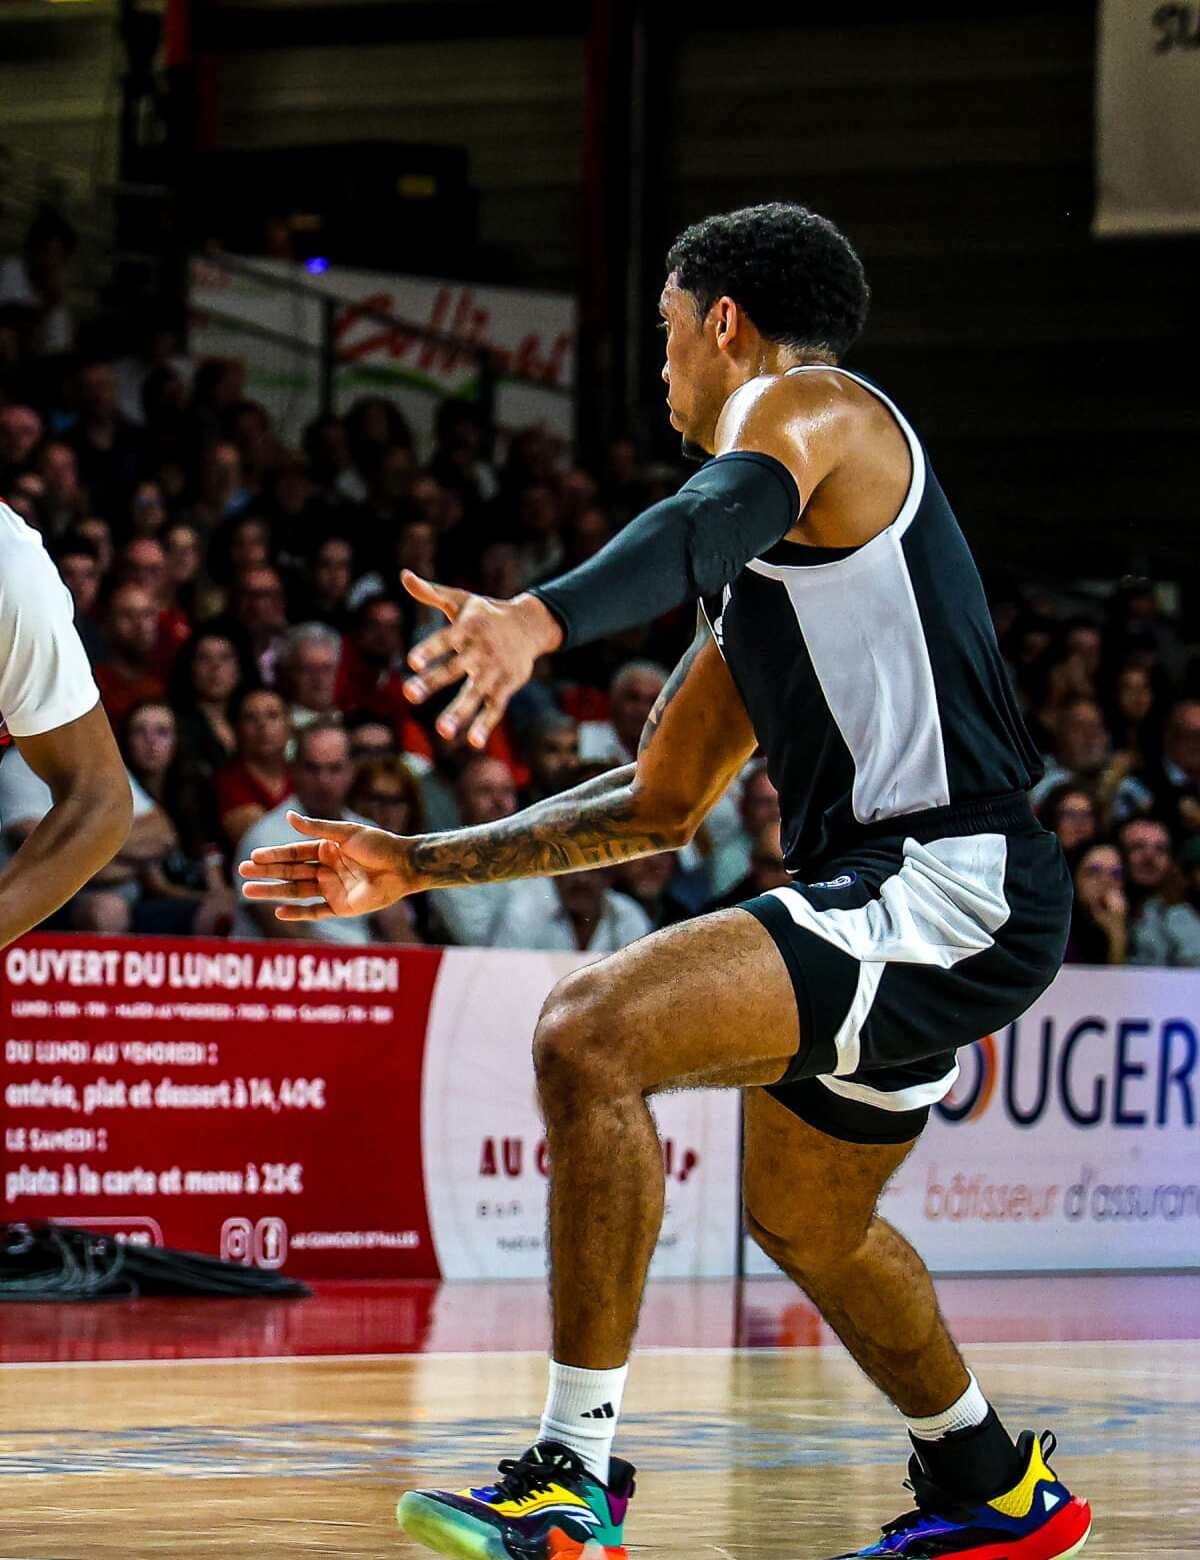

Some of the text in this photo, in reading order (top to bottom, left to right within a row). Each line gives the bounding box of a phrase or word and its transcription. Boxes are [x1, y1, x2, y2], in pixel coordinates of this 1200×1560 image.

[5, 947, 398, 992] OUVERT DU LUNDI AU SAMEDI
[479, 1137, 523, 1178] AU
